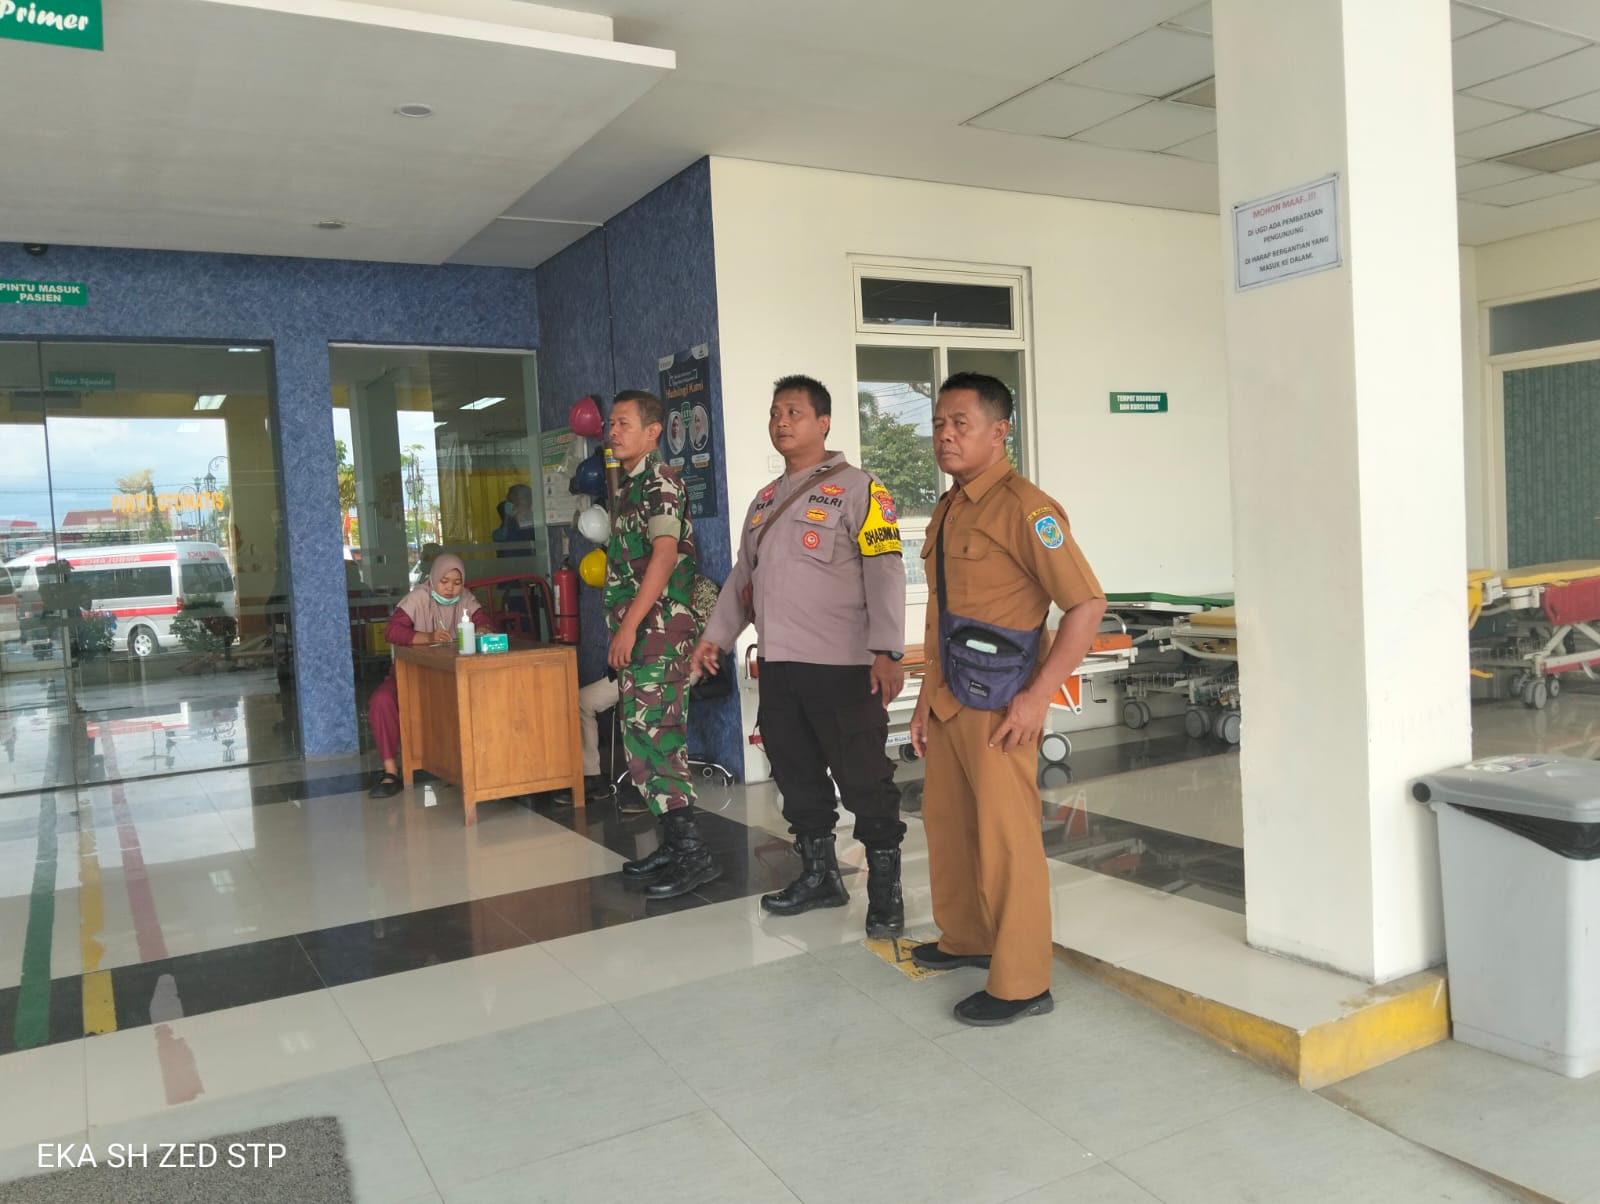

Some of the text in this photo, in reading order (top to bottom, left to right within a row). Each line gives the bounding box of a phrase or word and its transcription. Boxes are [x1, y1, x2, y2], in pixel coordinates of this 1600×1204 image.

[0, 0, 89, 31] Primer
[1253, 203, 1281, 218] MOHON
[1247, 208, 1324, 237] DI UGD ADA PEMBATASAN
[1264, 226, 1304, 242] PENGUNJUNG
[1244, 235, 1329, 265] DI HARAP BERGANTIAN YANG
[1259, 261, 1280, 273] MASUK
[1281, 258, 1289, 266] KE
[0, 283, 81, 294] PINTU MASUK
[20, 293, 62, 302] PASIEN
[111, 491, 225, 513] PINTU OTOMATIS
[808, 494, 842, 508] POLRI
